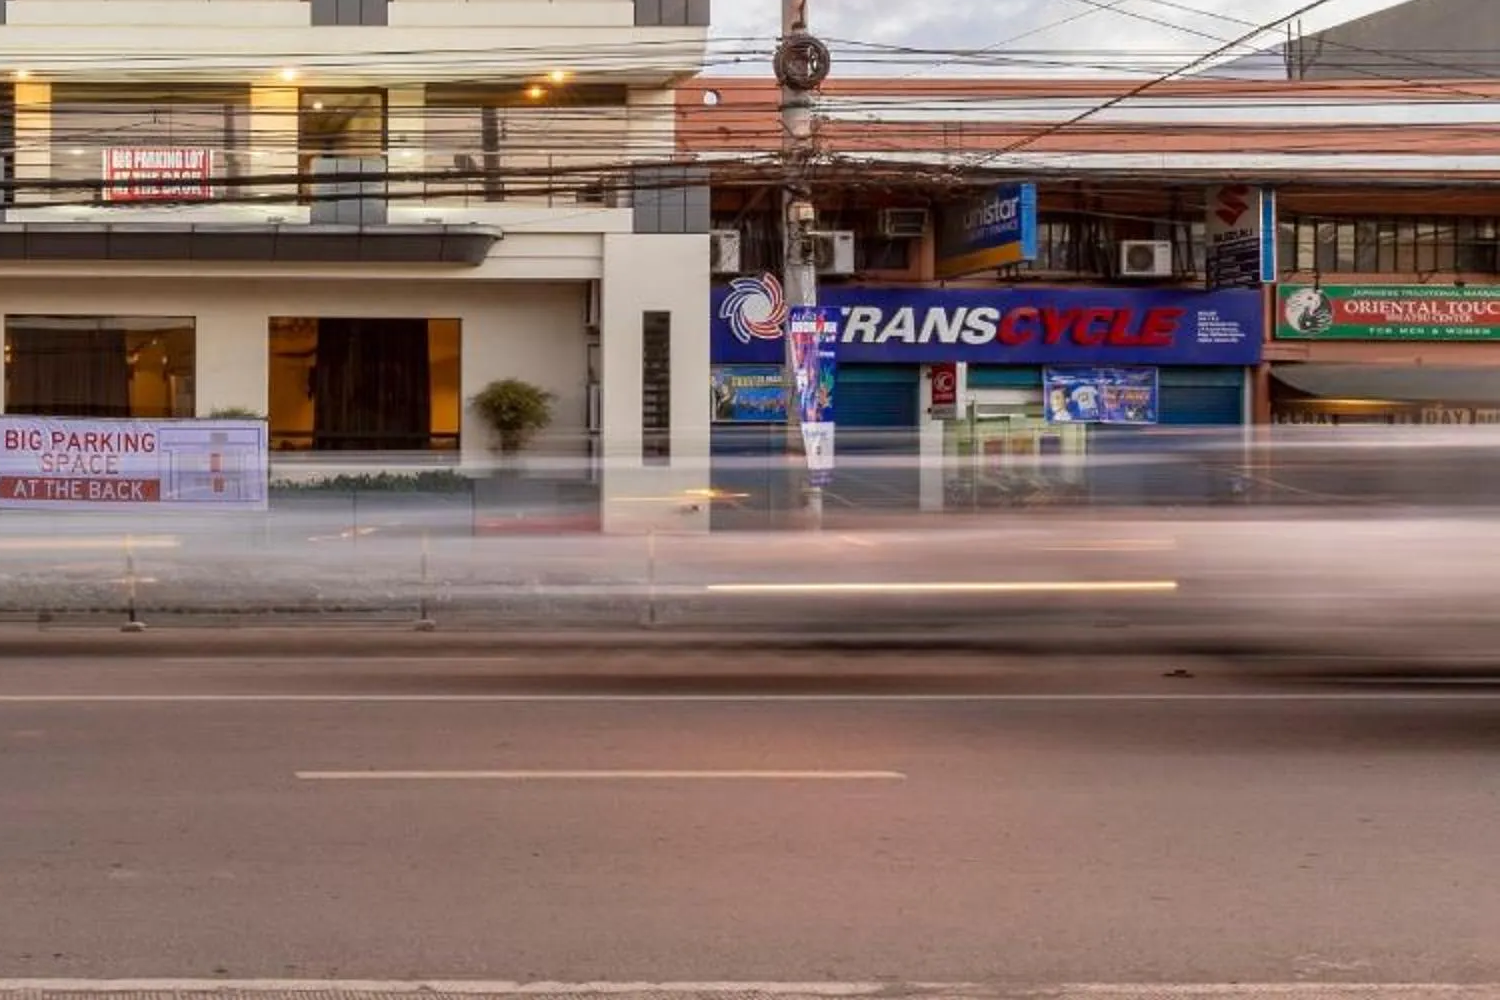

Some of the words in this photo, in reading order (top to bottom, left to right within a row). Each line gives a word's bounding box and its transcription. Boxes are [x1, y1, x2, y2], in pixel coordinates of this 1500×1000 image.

[1344, 301, 1442, 314] ORIENTAL
[1444, 301, 1500, 315] TOUC
[841, 306, 1189, 346] RANSCYCLE
[1368, 327, 1394, 335] FOR
[1399, 327, 1425, 335] MEN
[1445, 327, 1492, 335] WOMEN
[4, 429, 42, 450] BIG
[51, 431, 156, 453] PARKING
[41, 453, 119, 475] SPACE
[14, 479, 38, 497] AT
[43, 479, 81, 498] THE
[89, 480, 143, 500] BACK
